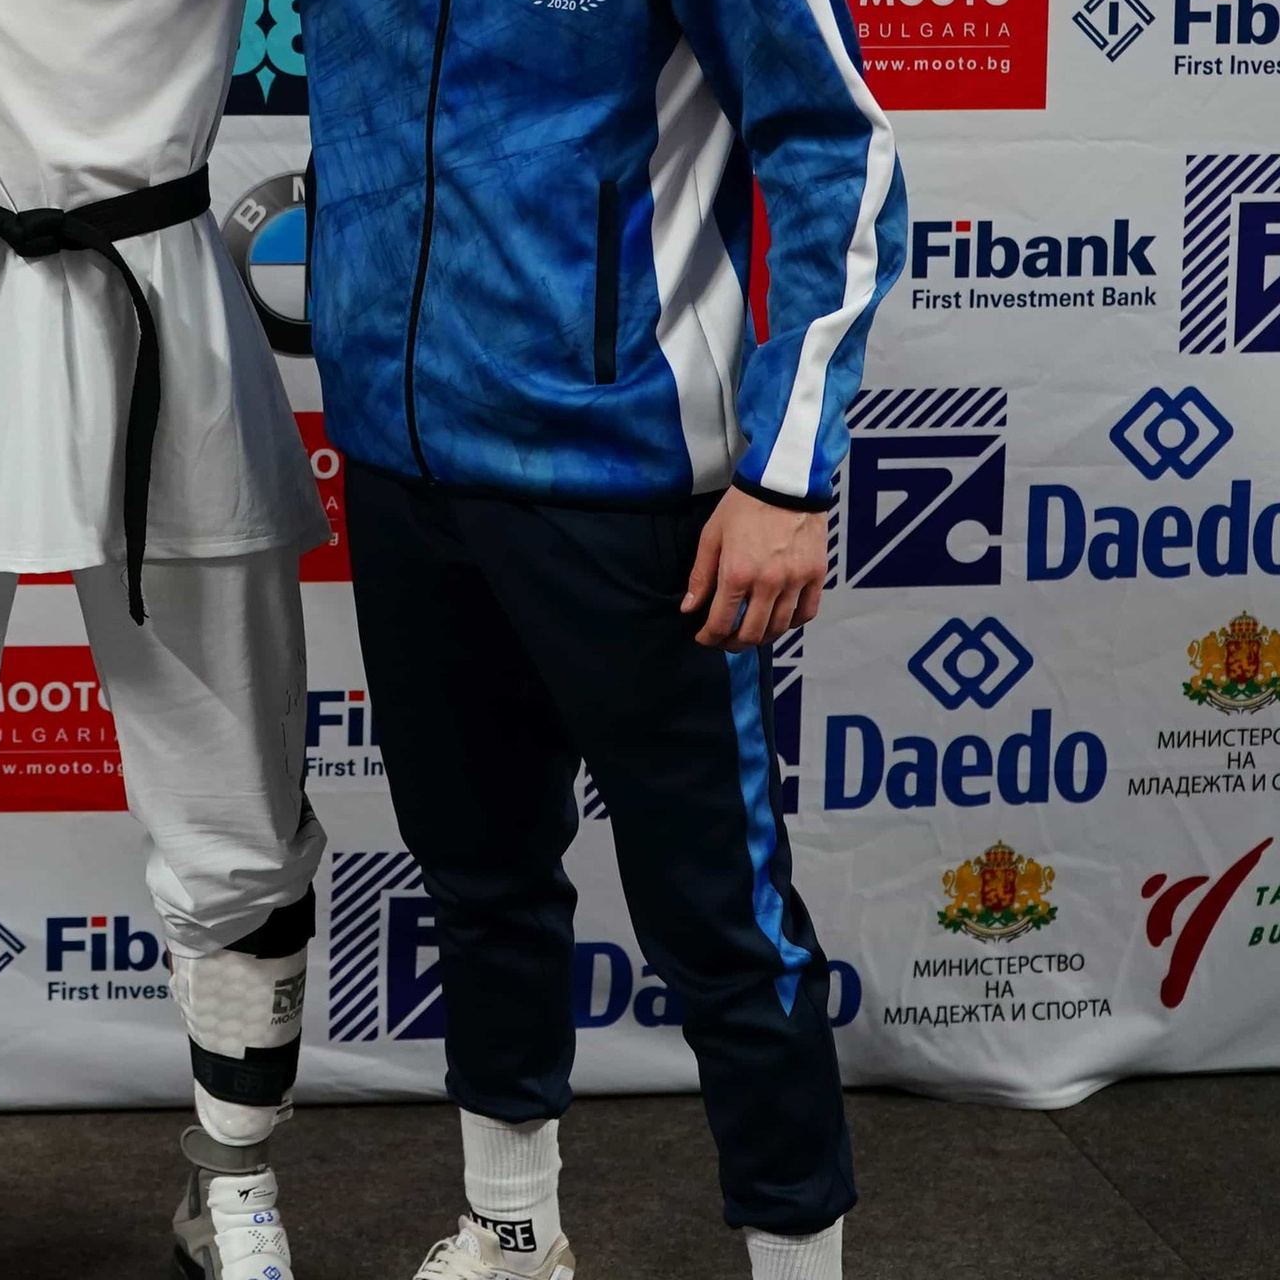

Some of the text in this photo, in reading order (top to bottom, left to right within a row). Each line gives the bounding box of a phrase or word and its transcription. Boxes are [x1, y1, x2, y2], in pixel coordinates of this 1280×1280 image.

[858, 22, 1011, 39] BULGARIA
[1175, 55, 1280, 75] First Inves
[912, 219, 1157, 279] Fibank
[913, 286, 1156, 309] First Investment Bank
[1158, 728, 1280, 749] МИНИСТЕРС
[824, 709, 1107, 810] Daedo
[1228, 752, 1255, 769] НА
[1128, 775, 1245, 797] МЛАДЕЖТА
[1252, 774, 1265, 791] И
[46, 916, 166, 973] Fib
[914, 953, 1084, 978] МИНИСТЕРСТВО
[48, 981, 169, 1001] First Inves
[986, 980, 1014, 998] НА
[884, 999, 1111, 1027] МЛАДЕЖТА И СПОРТА
[253, 1211, 275, 1224] G3
